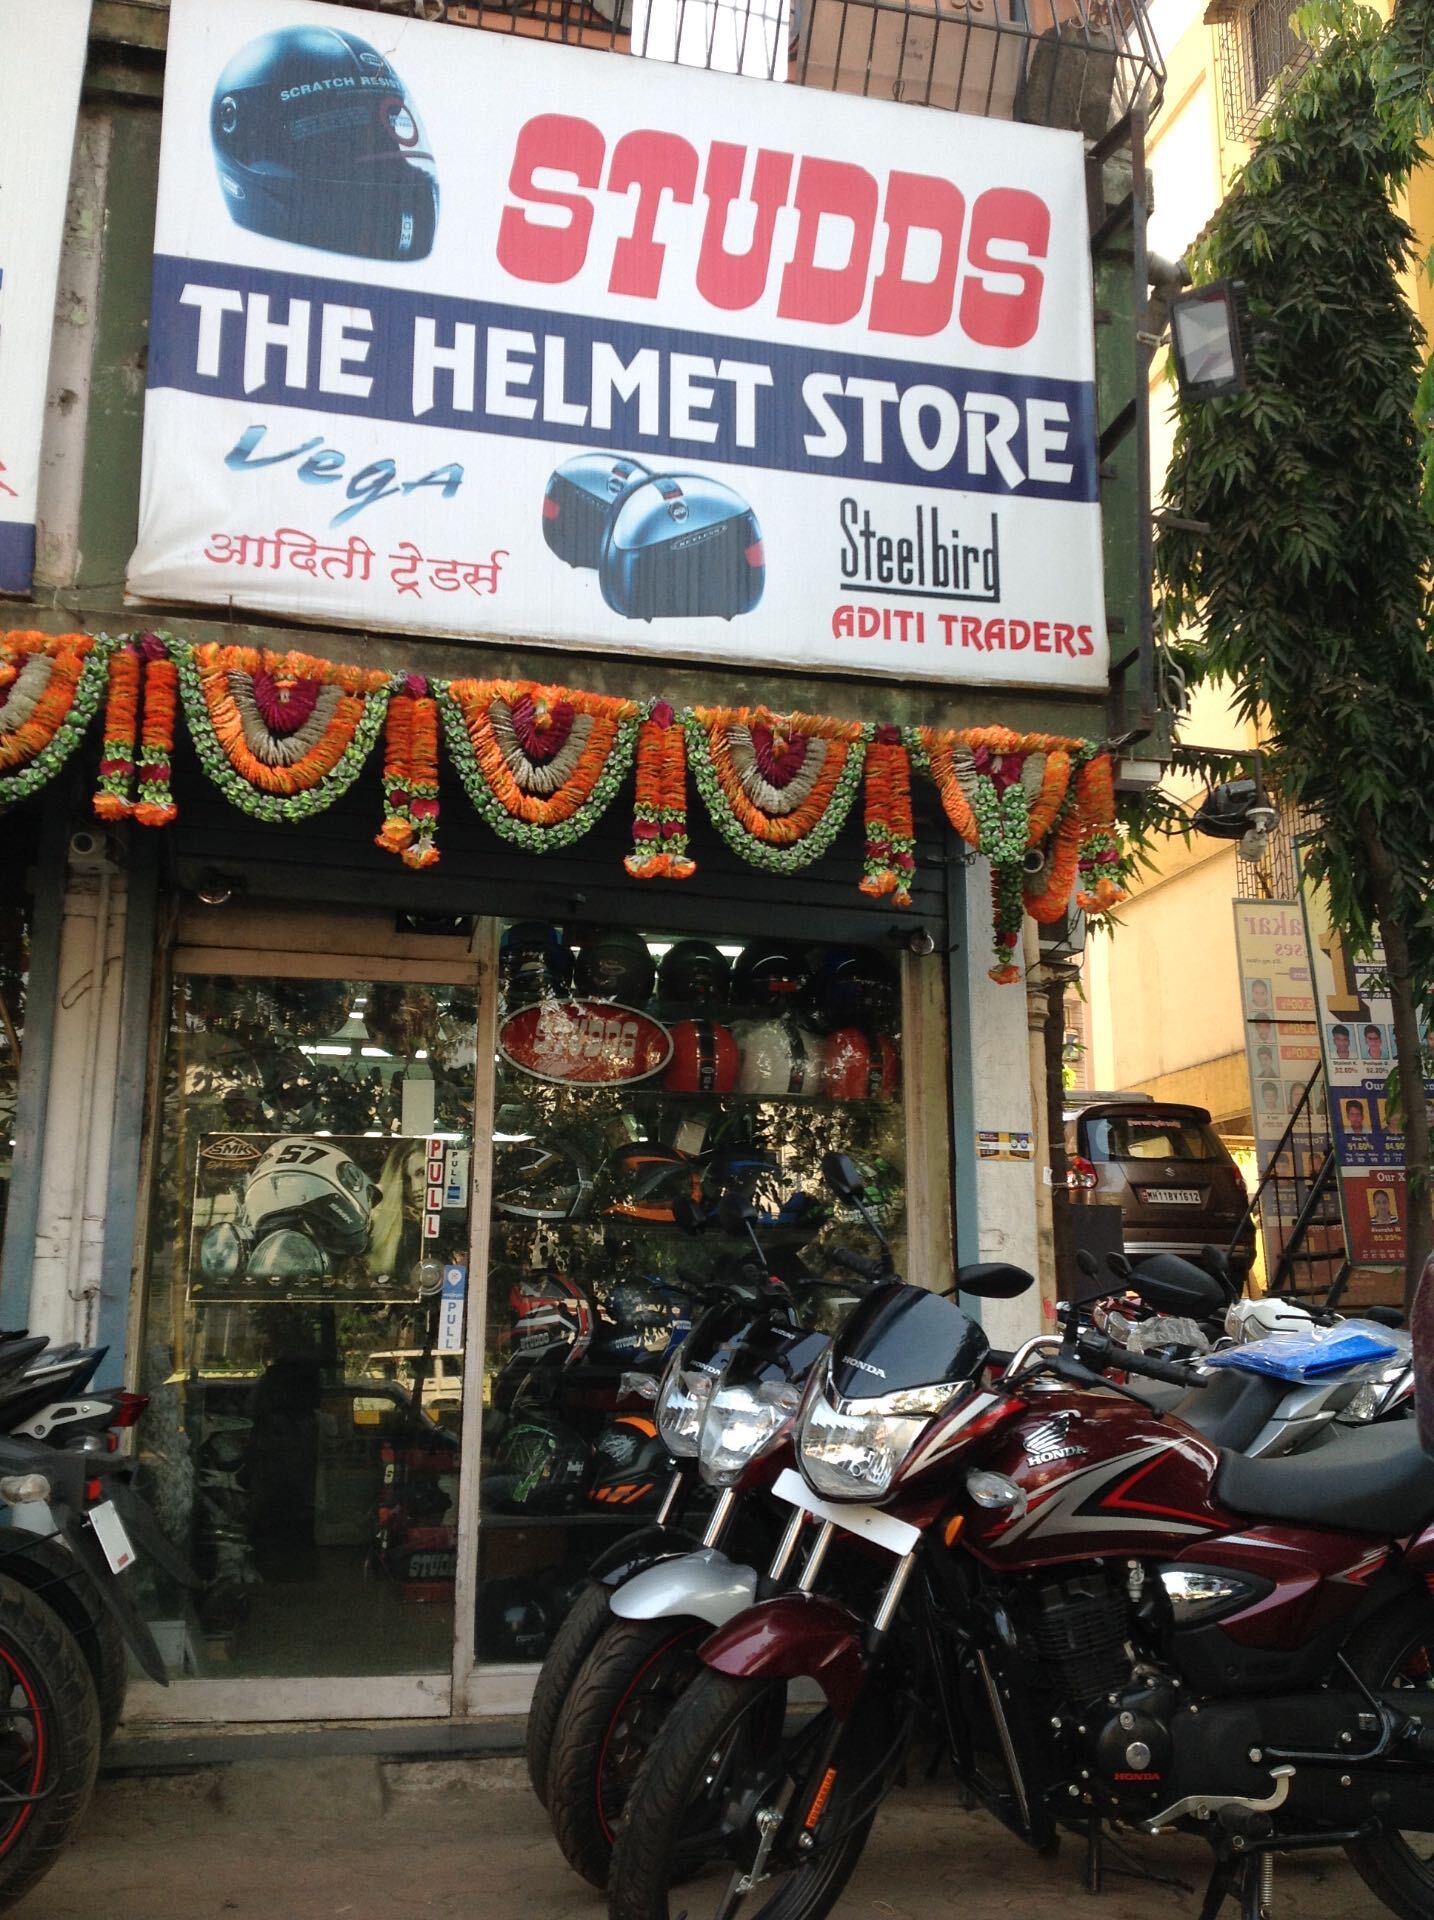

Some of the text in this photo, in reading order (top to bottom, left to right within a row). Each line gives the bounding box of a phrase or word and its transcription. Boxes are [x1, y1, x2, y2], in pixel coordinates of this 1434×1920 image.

[280, 77, 356, 101] SCRATCH
[496, 112, 1050, 348] STUDDS
[180, 283, 1074, 489] THE HELMET STORE
[840, 497, 1000, 597] Steelbird
[203, 529, 509, 599] आदिती ट्रेडर्स
[832, 604, 1094, 659] ADITI TRADERS
[1365, 1081, 1385, 1090] Our
[209, 1141, 252, 1155] SMK
[275, 1144, 330, 1165] 57
[450, 1151, 458, 1185] PULL
[1377, 1172, 1395, 1182] Our
[428, 1139, 442, 1235] PULL
[446, 1302, 457, 1349] PULL
[770, 1327, 796, 1340] SUZUKI
[690, 1359, 721, 1376] HONDA
[842, 1356, 887, 1379] HONDA
[1027, 1445, 1088, 1468] HONDA
[1113, 1772, 1160, 1781] HONDA
